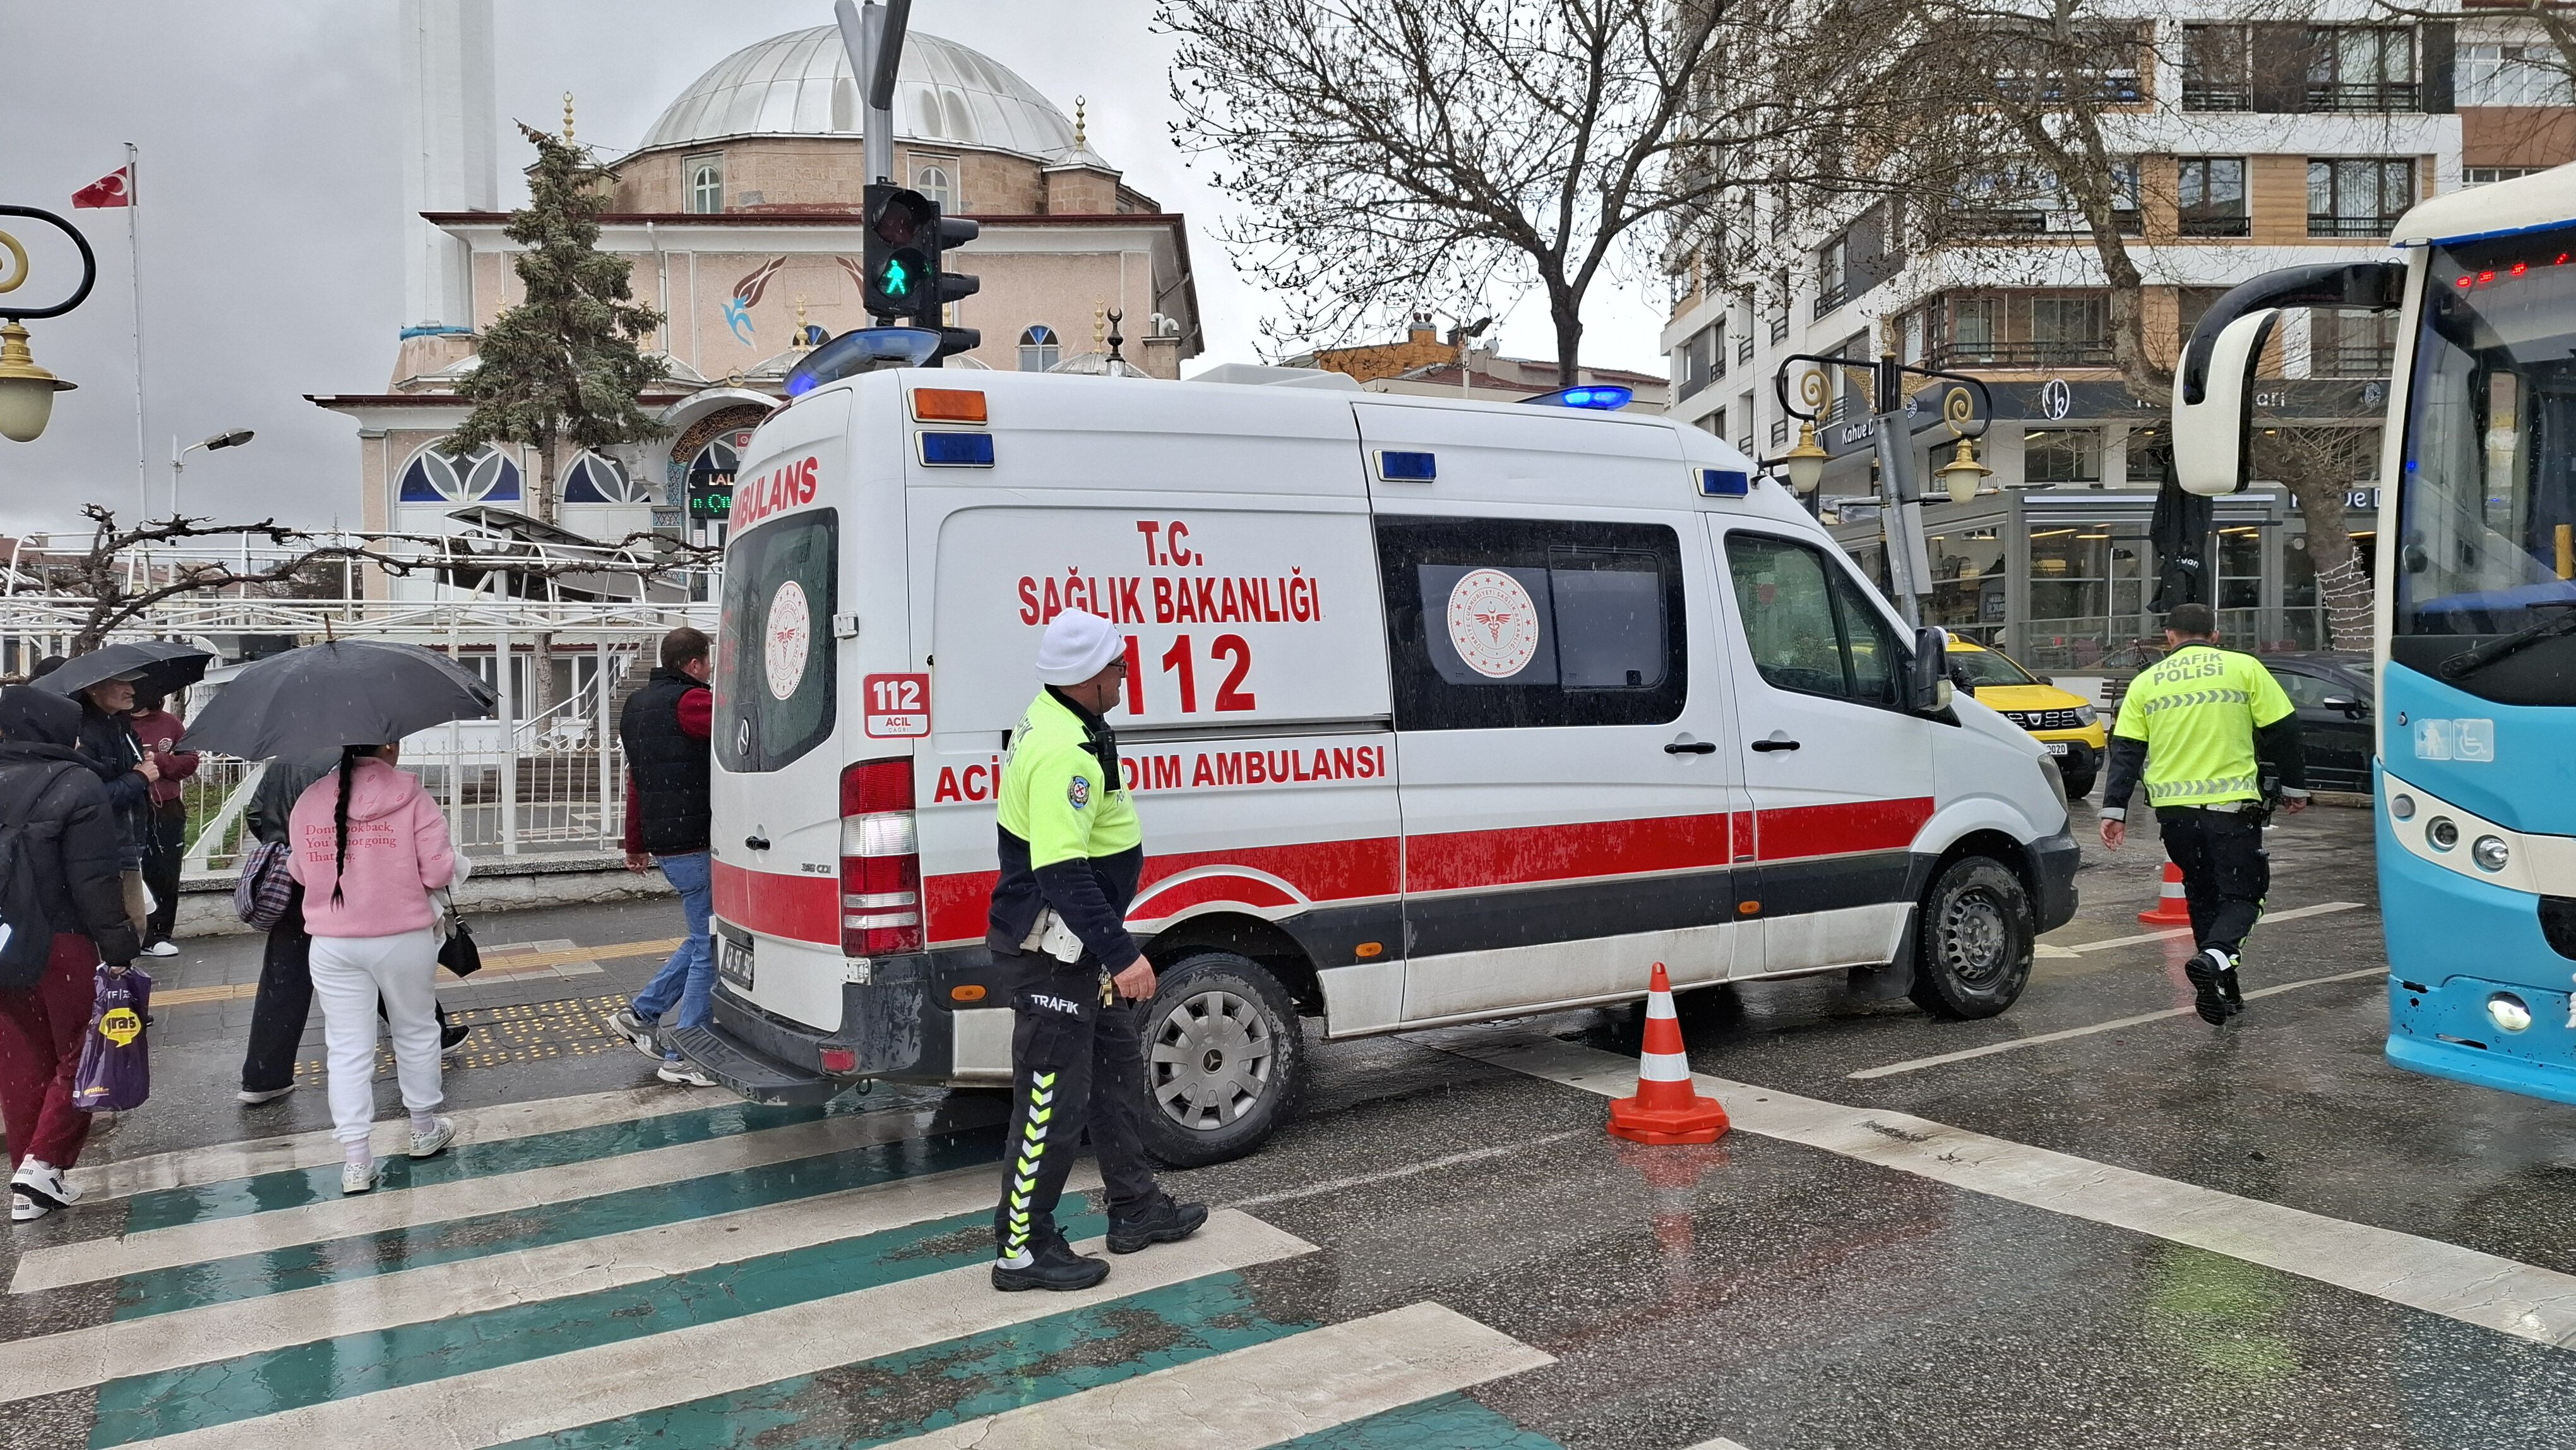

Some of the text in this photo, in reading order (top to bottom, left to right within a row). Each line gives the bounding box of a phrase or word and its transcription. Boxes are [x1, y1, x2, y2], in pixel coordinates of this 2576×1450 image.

[1136, 520, 1203, 566] T.C.
[1018, 566, 1321, 626] SAĞLIK BAKANLIĞI
[1119, 633, 1256, 715] 112
[2154, 663, 2223, 686] POLİSİ
[2156, 653, 2222, 671] TRAFİK
[873, 680, 921, 710] 112
[934, 745, 1385, 803] ACİ DIM AMBULANSI
[366, 822, 394, 833] back,
[364, 836, 397, 848] going
[306, 851, 335, 863] That
